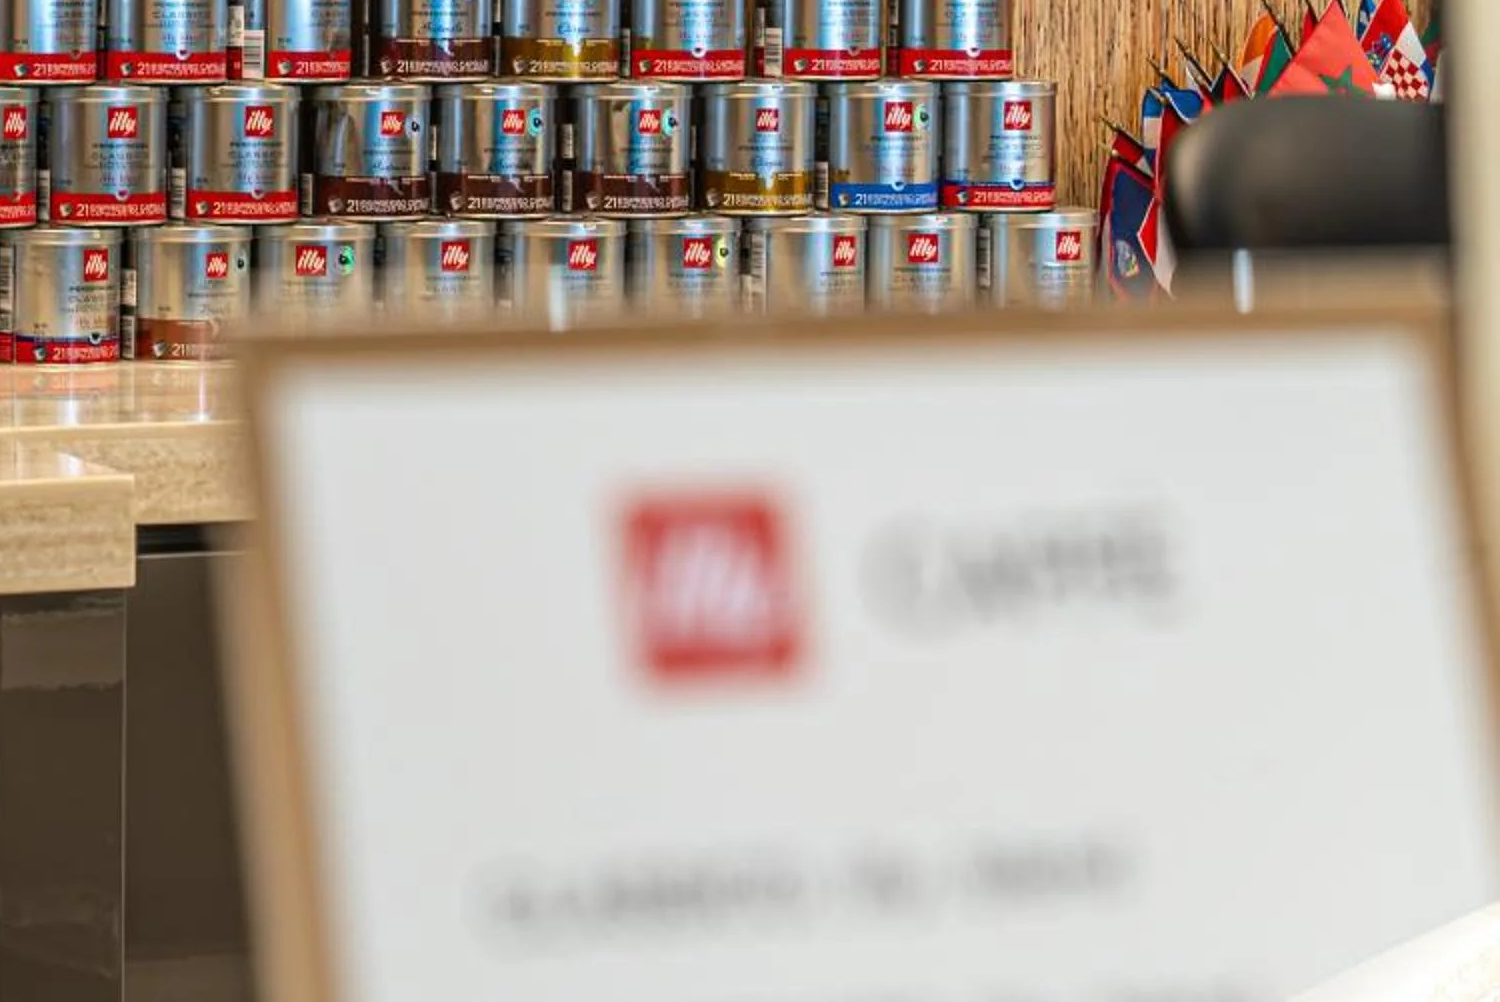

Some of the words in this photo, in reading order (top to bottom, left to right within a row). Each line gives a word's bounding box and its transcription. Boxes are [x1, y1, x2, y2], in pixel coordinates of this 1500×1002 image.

[5, 111, 25, 136] illy
[109, 111, 136, 136] illy
[246, 110, 272, 134] illy
[382, 115, 402, 134] illy
[504, 113, 524, 133] illy
[640, 113, 659, 132] illy
[757, 112, 777, 130] illy
[886, 105, 911, 130] illy
[1006, 105, 1030, 128] illy
[443, 245, 468, 269] illy
[570, 244, 595, 268] illy
[685, 242, 711, 266] illy
[835, 240, 854, 264] illy
[910, 237, 937, 260] illy
[1058, 235, 1079, 258] illy
[84, 254, 107, 279] illy
[207, 257, 227, 275] illy
[298, 250, 325, 273] illy
